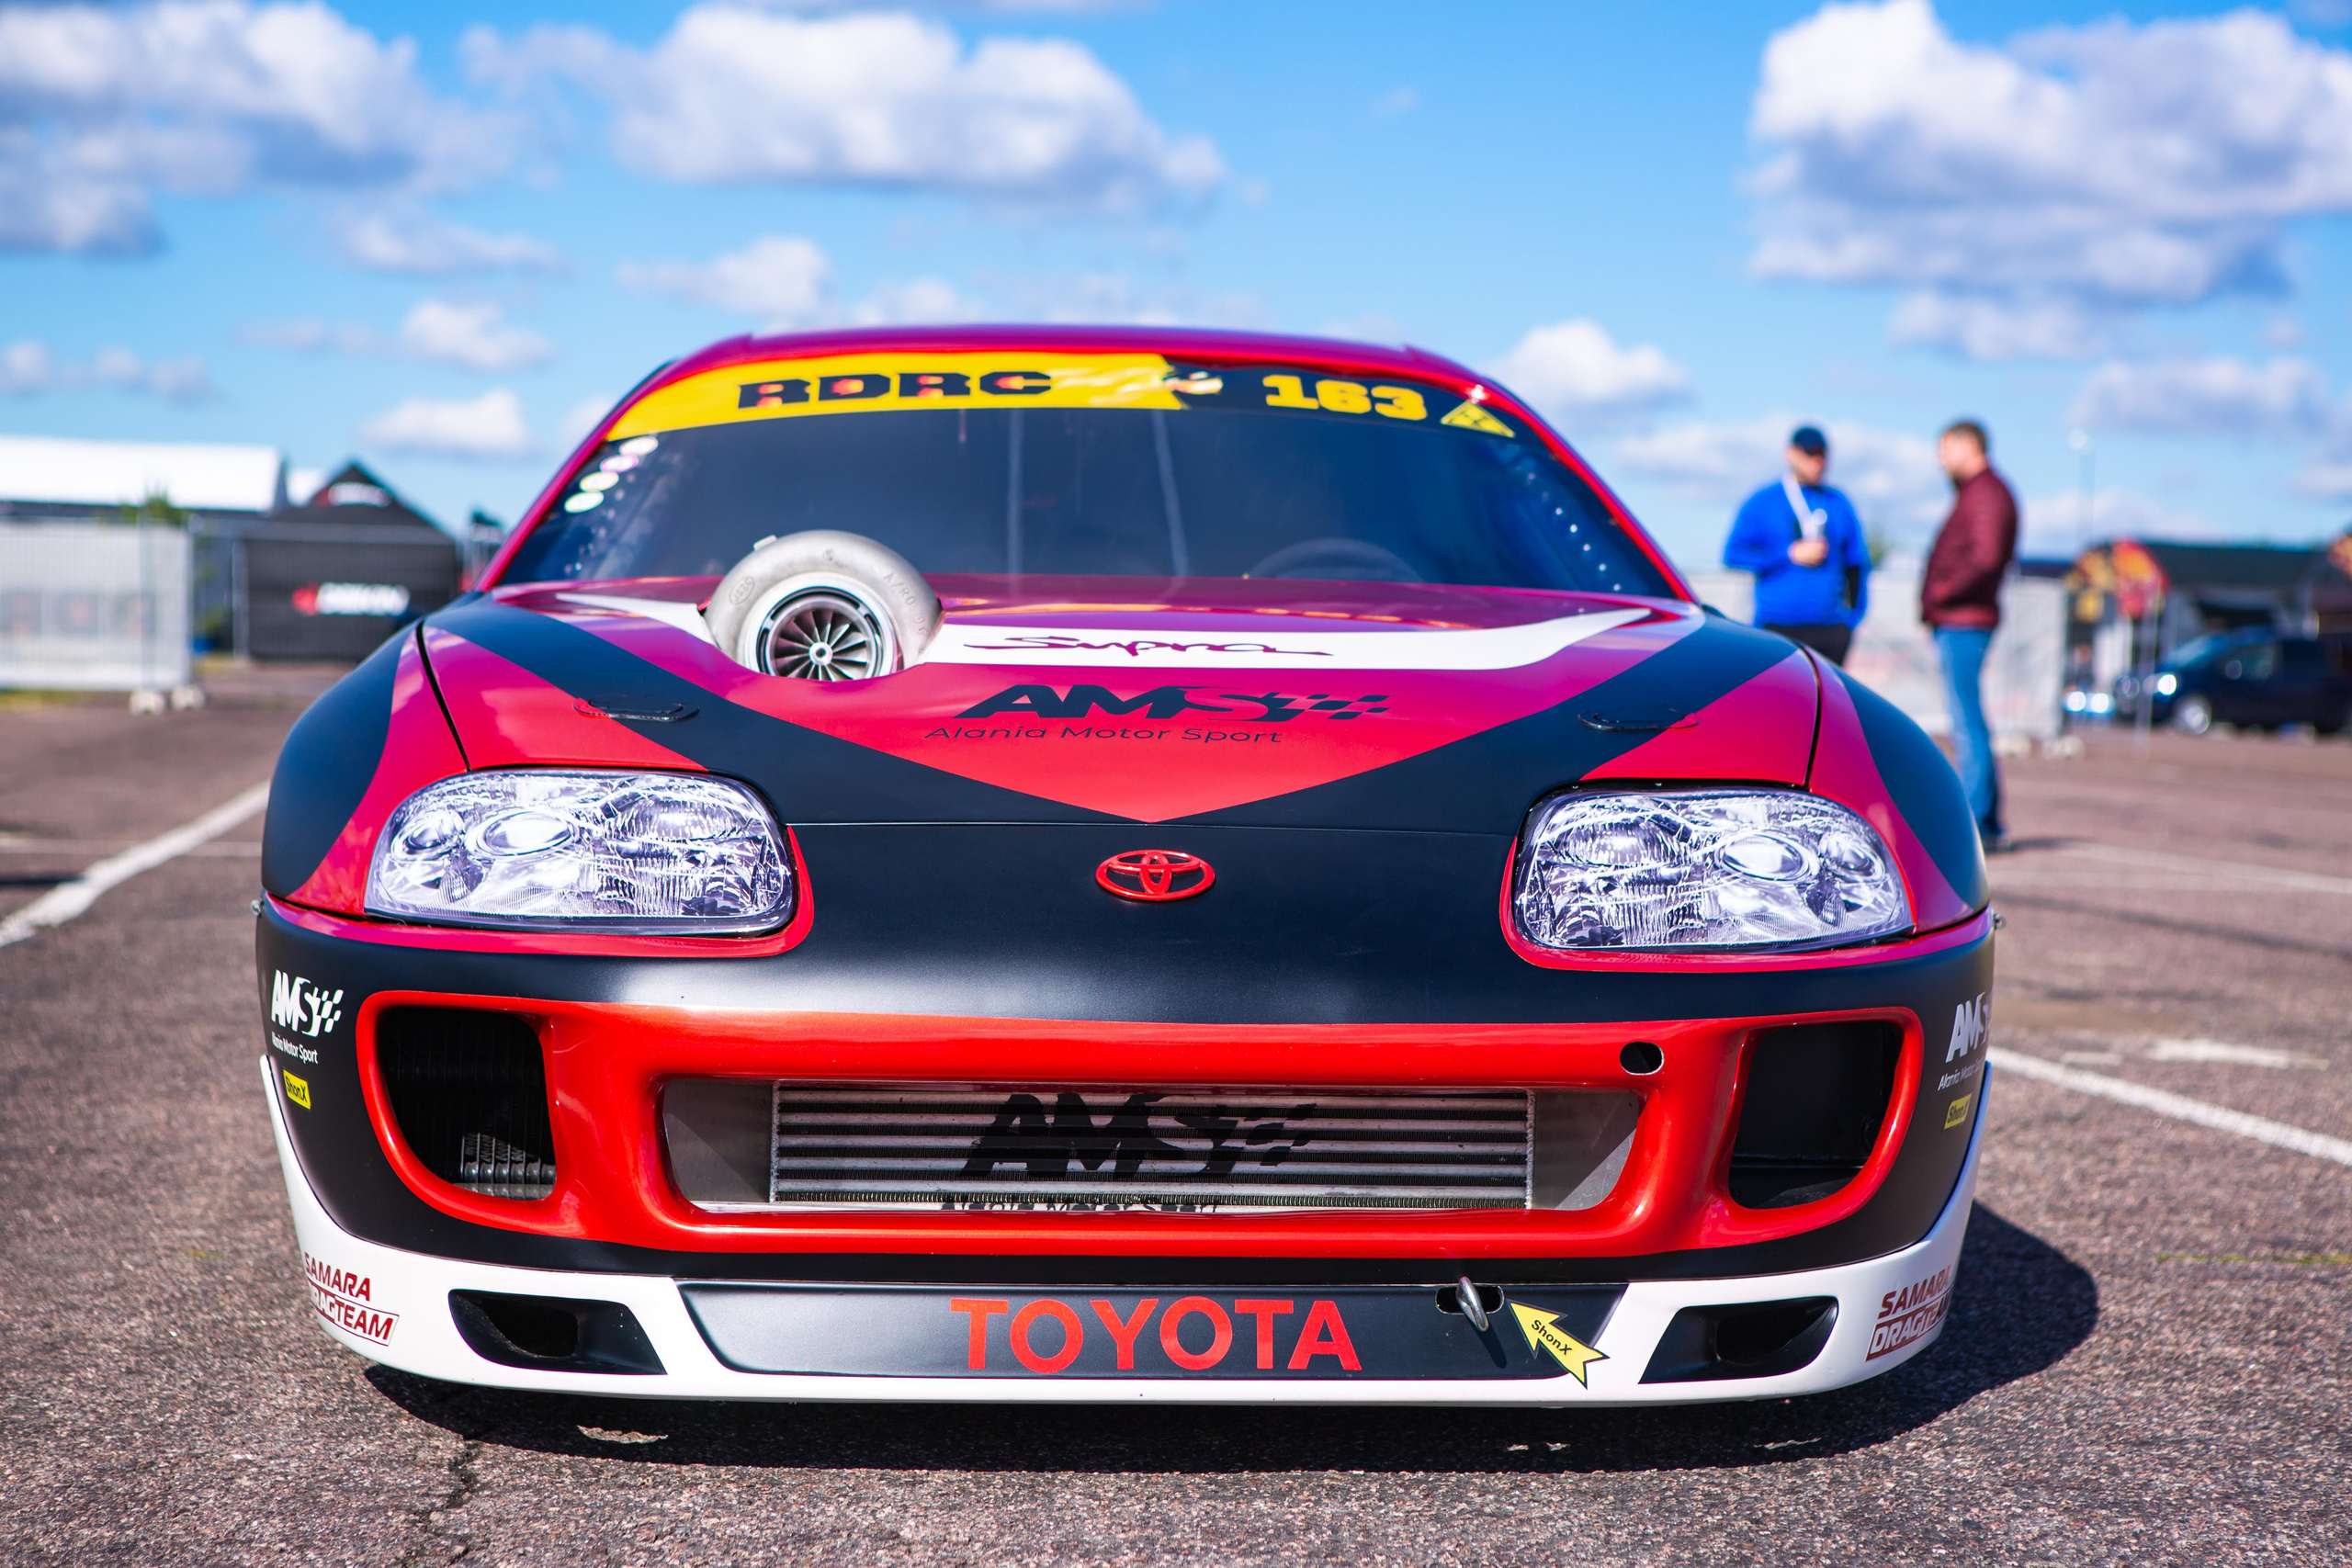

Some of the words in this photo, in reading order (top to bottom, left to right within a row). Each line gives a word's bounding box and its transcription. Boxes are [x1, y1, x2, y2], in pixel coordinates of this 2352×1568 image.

[738, 371, 1052, 410] RDRC
[1262, 374, 1428, 421] 163
[963, 636, 1335, 657] Supra
[924, 727, 1046, 739] Alania
[1061, 727, 1170, 739] Motor
[1182, 728, 1283, 743] Sport
[299, 1043, 319, 1065] Sport
[304, 1251, 370, 1303] SAMARA
[1877, 1266, 1951, 1320] SAMARA
[950, 1295, 1363, 1374] TOYOTA
[1531, 1319, 1573, 1356] ShonX
